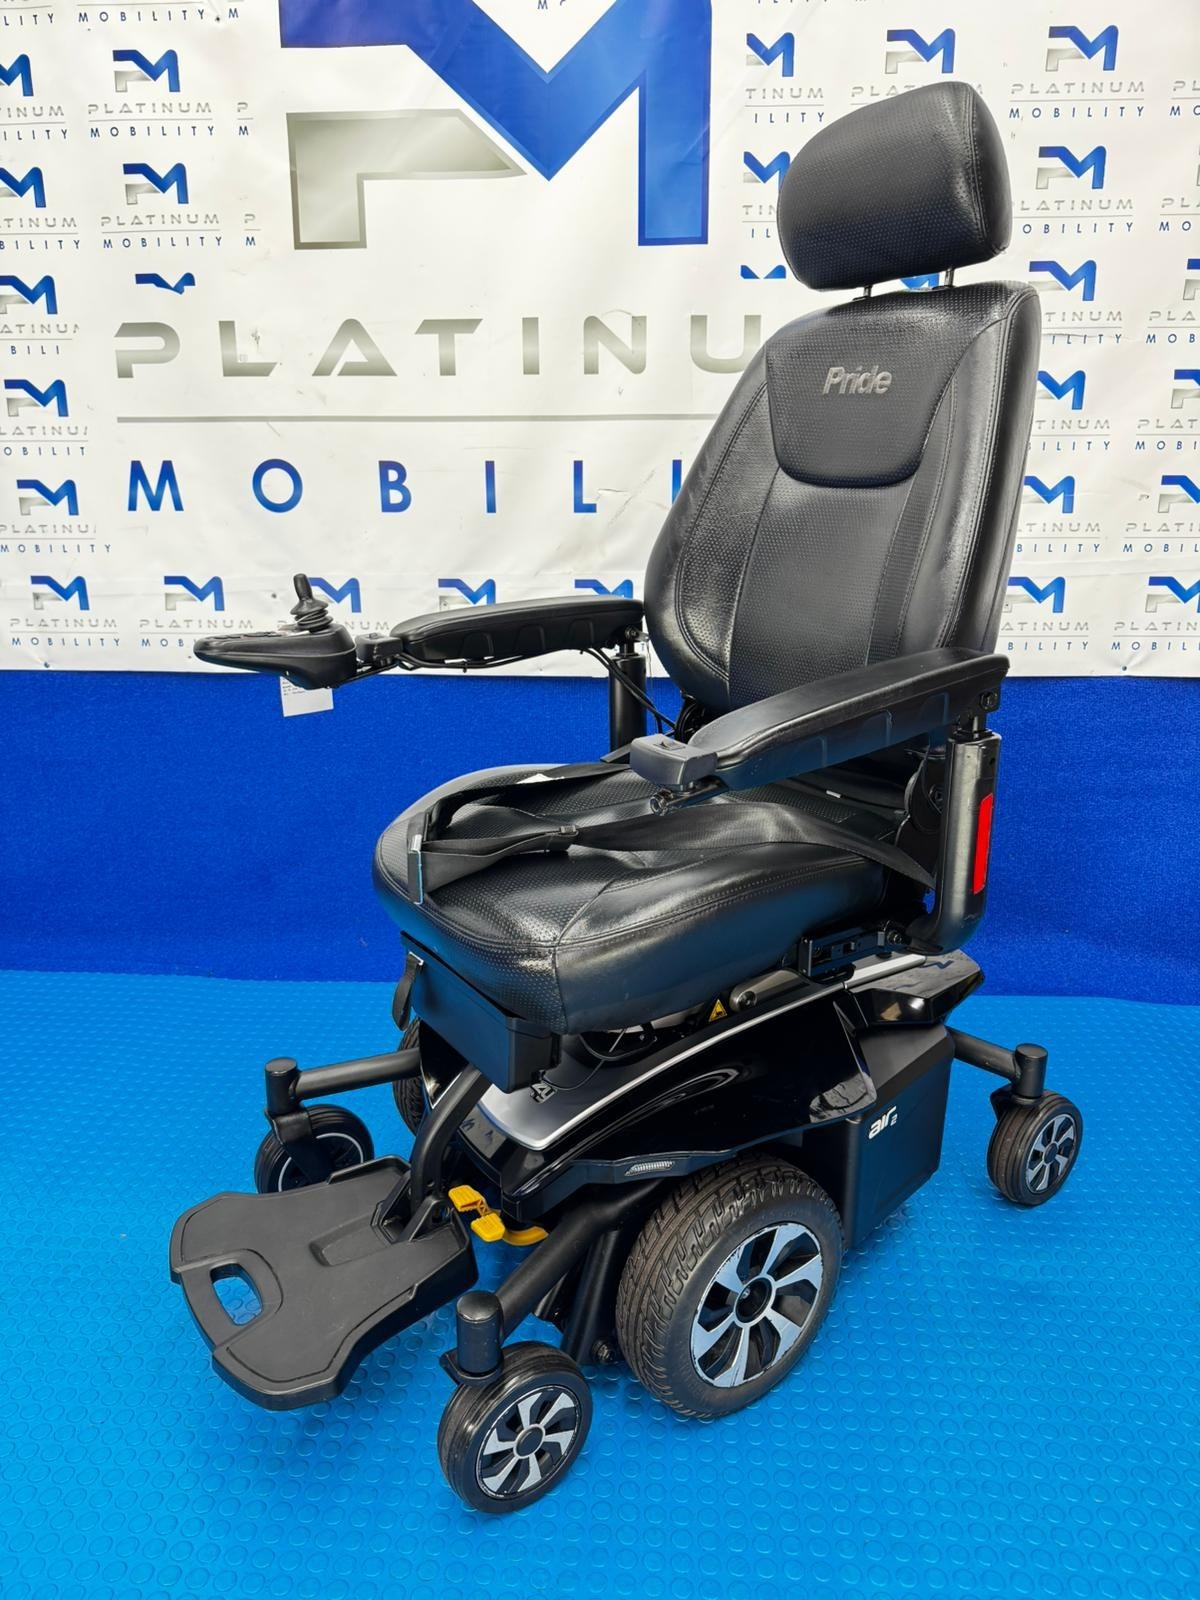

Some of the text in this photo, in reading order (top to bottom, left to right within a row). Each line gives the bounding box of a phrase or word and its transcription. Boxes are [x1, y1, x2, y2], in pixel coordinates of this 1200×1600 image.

[78, 9, 205, 23] MOBILITY
[1010, 80, 1145, 95] PLATINUM
[0, 105, 65, 118] INUM
[88, 102, 212, 115] PLATINUM
[1009, 106, 1145, 119] MOBILITY
[90, 126, 214, 138] MOBILITY
[1020, 199, 1134, 211] LATINUM
[0, 217, 77, 228] TINUM
[101, 213, 219, 226] PLATINUM
[1022, 221, 1133, 235] OBILITY
[103, 236, 222, 248] MOBILITY
[113, 314, 762, 379] PLATINU
[823, 365, 892, 394] Pride
[128, 458, 682, 514] MOBILI
[0, 524, 96, 534] PLATINU
[1125, 522, 1200, 532] PLATI
[0, 544, 111, 554] MOBILITY
[10, 618, 117, 629] PLATINUM
[139, 619, 253, 629] PLATINUM
[12, 638, 120, 648] MOBILITY
